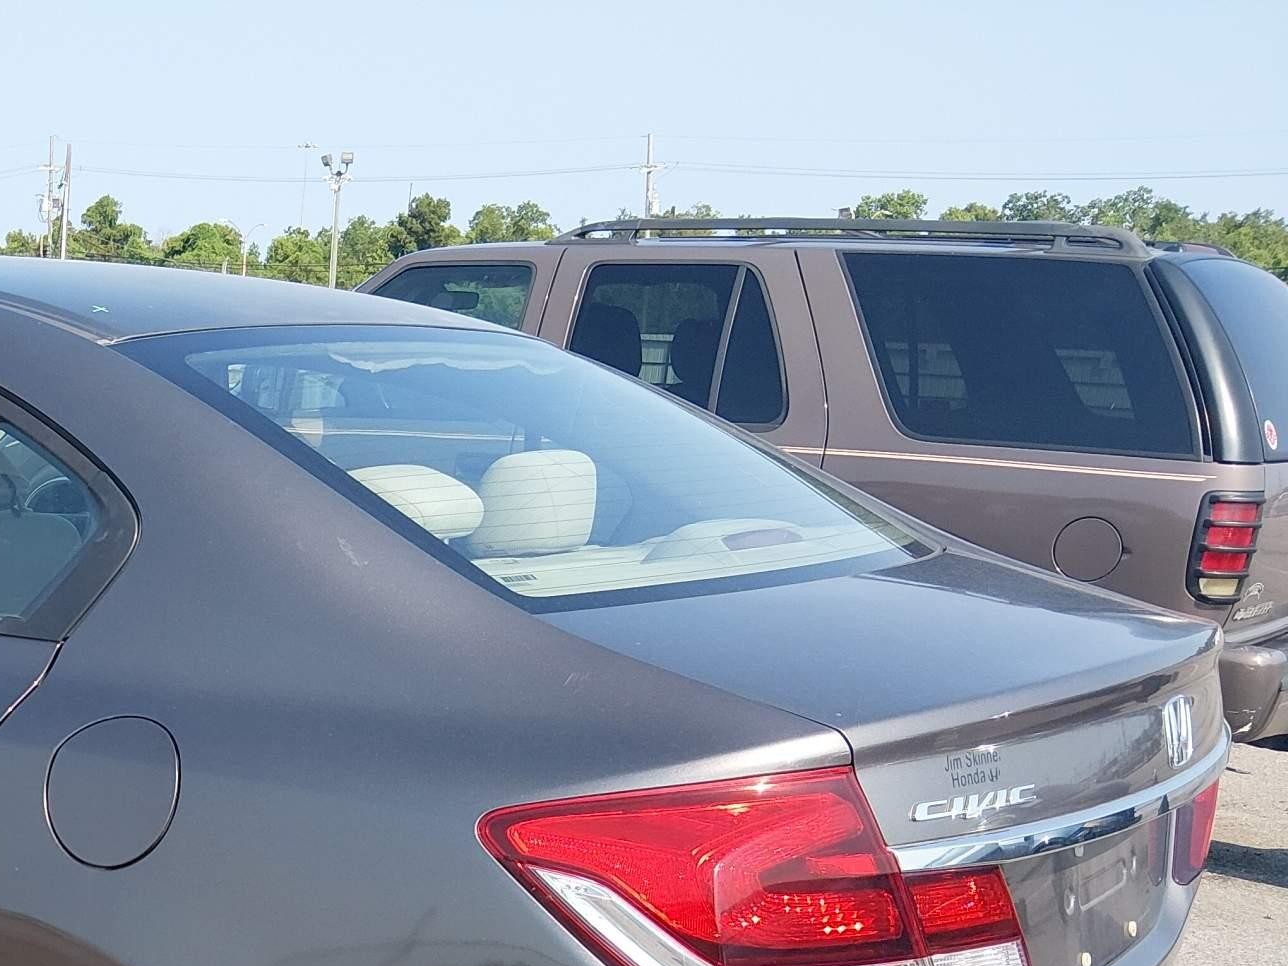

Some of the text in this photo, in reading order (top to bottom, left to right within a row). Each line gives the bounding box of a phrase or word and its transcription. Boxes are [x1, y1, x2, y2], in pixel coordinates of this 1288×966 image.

[945, 755, 963, 772] Jim
[951, 768, 986, 788] Honda
[909, 784, 1037, 821] CIVIC
